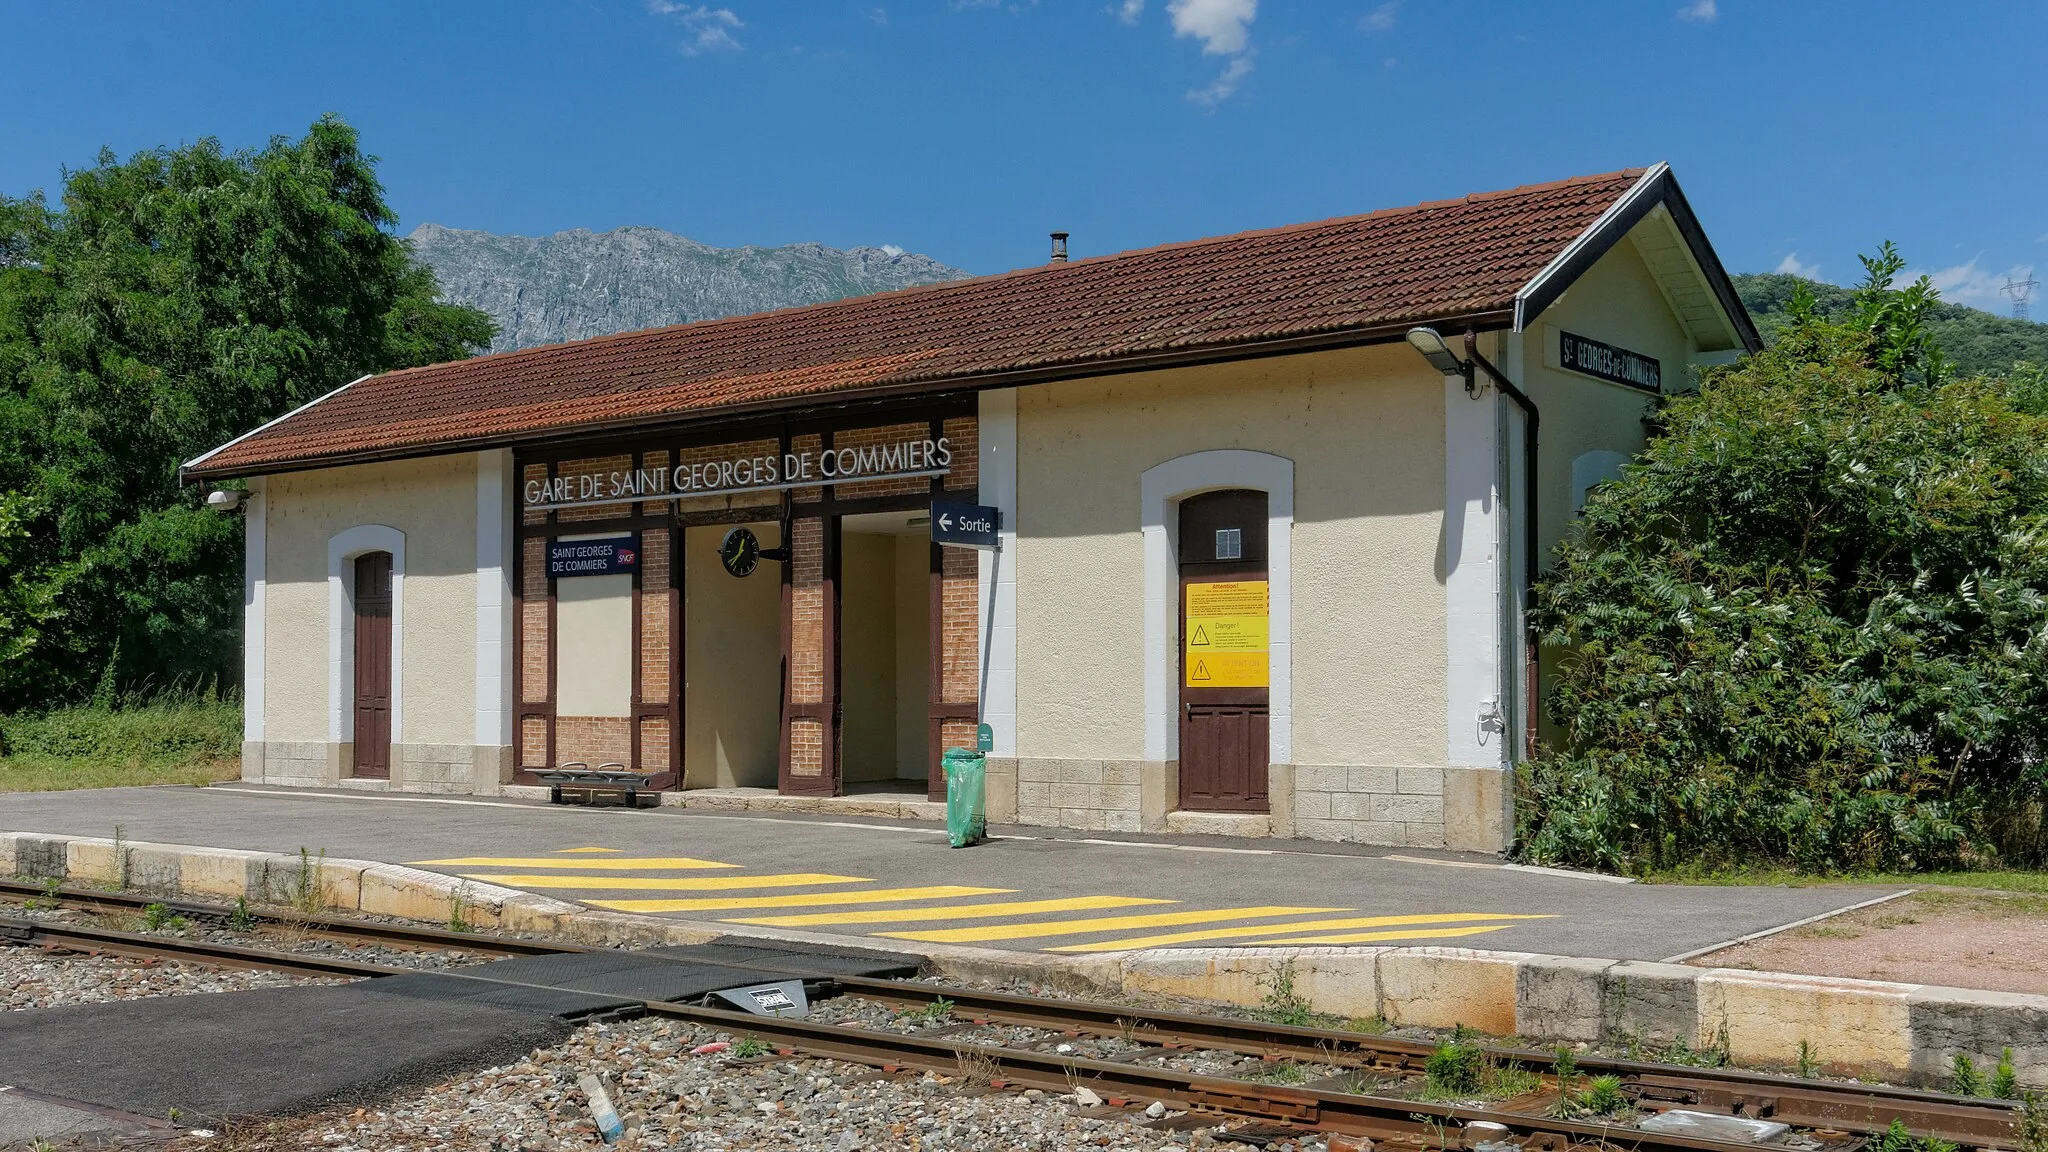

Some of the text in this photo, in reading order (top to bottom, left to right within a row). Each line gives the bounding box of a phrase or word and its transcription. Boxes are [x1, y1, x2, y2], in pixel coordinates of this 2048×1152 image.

[525, 438, 951, 503] GARE DE SAINT GEORGES DE COMMIERS
[959, 516, 991, 533] Sortie
[552, 545, 613, 559] SAINT GEORGES
[617, 553, 634, 563] SNCF
[552, 558, 607, 572] DE COMMIERS
